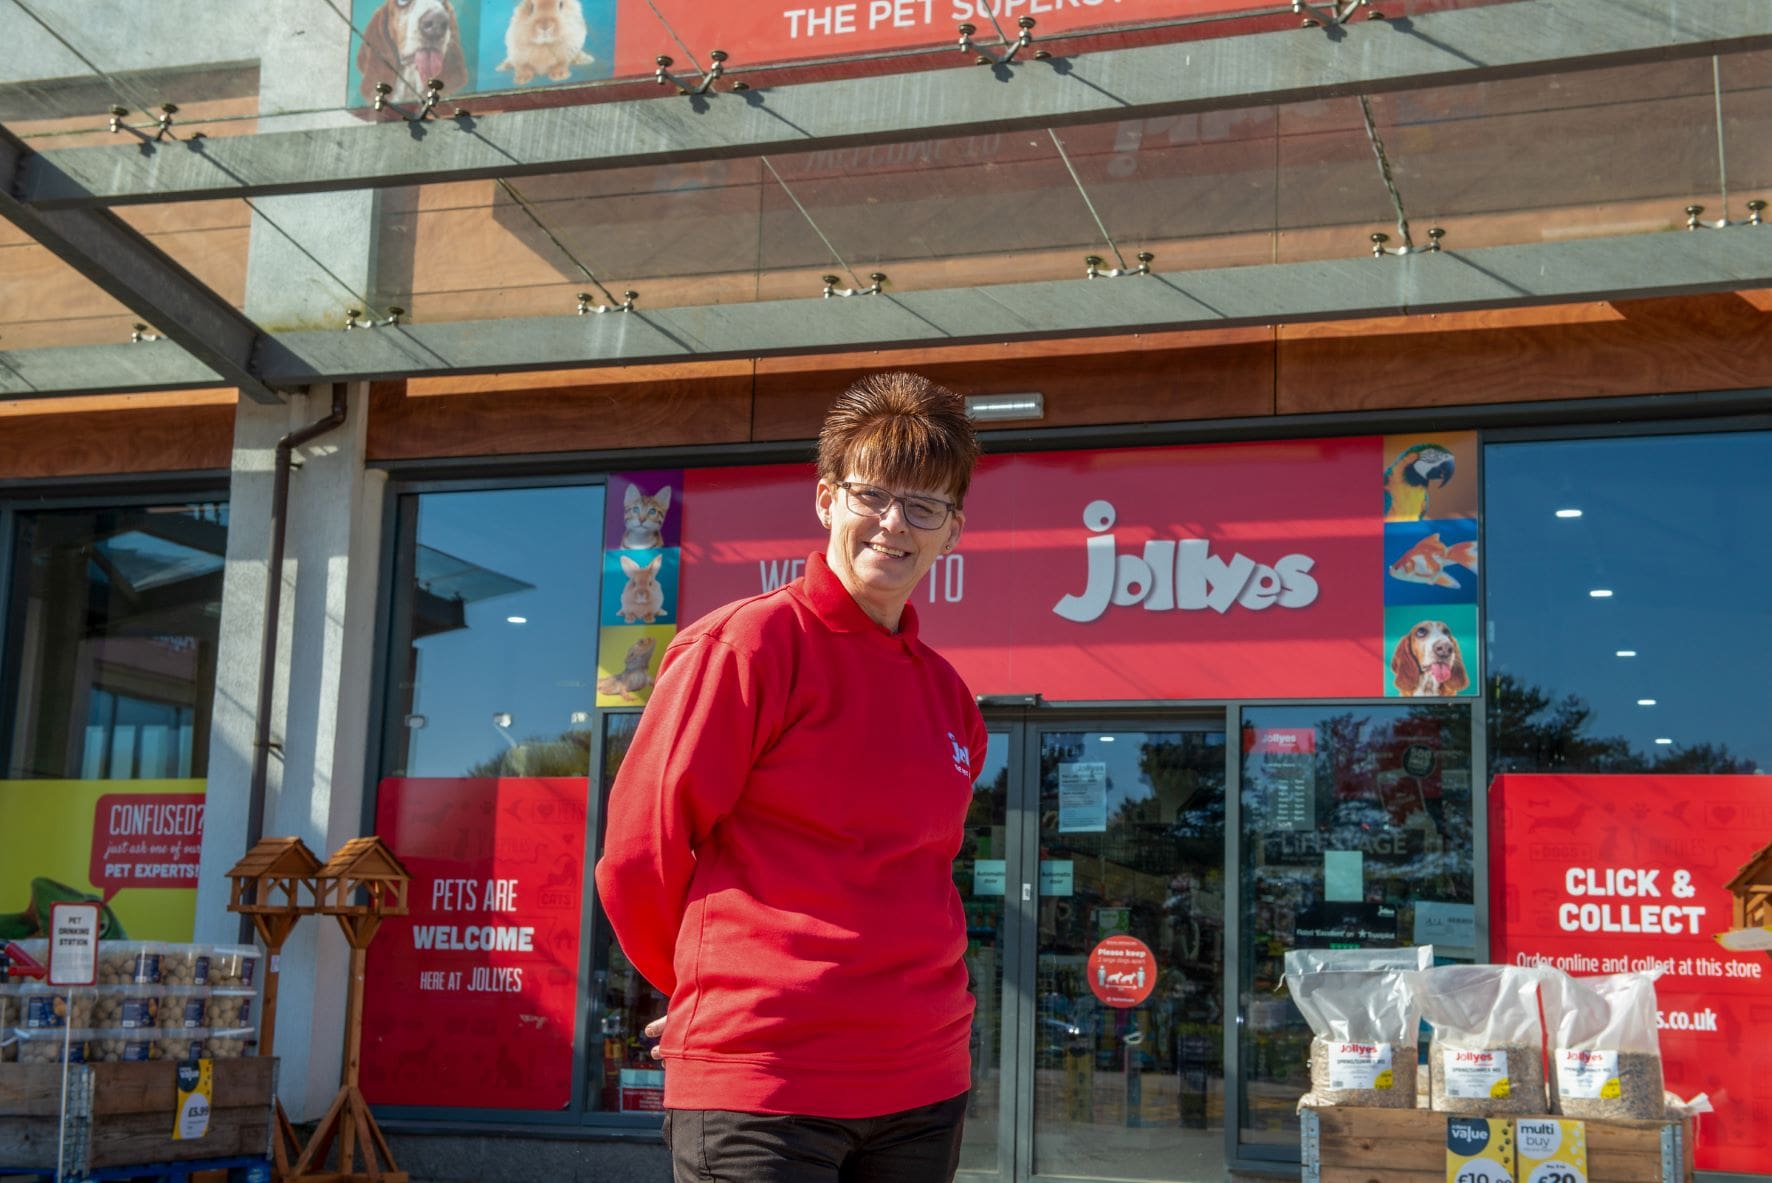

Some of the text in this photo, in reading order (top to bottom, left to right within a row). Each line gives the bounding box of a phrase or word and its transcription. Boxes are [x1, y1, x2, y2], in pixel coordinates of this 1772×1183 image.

[784, 9, 857, 39] THE
[869, 0, 935, 31] PET
[1052, 500, 1321, 623] jollyes
[929, 553, 964, 604] TO
[109, 804, 206, 836] CONFUSED?
[103, 840, 128, 860] just
[129, 840, 147, 854] ask
[150, 845, 167, 854] one
[170, 840, 182, 861] of
[105, 864, 201, 878] PET EXPERTS!
[1565, 867, 1696, 898] CLICK &
[432, 879, 519, 912] PETS ARE
[68, 916, 82, 925] PET
[1558, 903, 1706, 934] COLLECT
[58, 927, 89, 936] DRINKING
[59, 938, 89, 946] STATION
[413, 925, 535, 952] WELCOME
[1517, 952, 1762, 979] Order online and collect at this store
[420, 967, 523, 993] HERE AT JOLLYES
[1340, 1044, 1377, 1055] Jollyes
[1456, 1052, 1493, 1063] Jollyes
[1451, 1125, 1489, 1143] value
[1521, 1124, 1555, 1135] multi
[1526, 1136, 1551, 1149] buy
